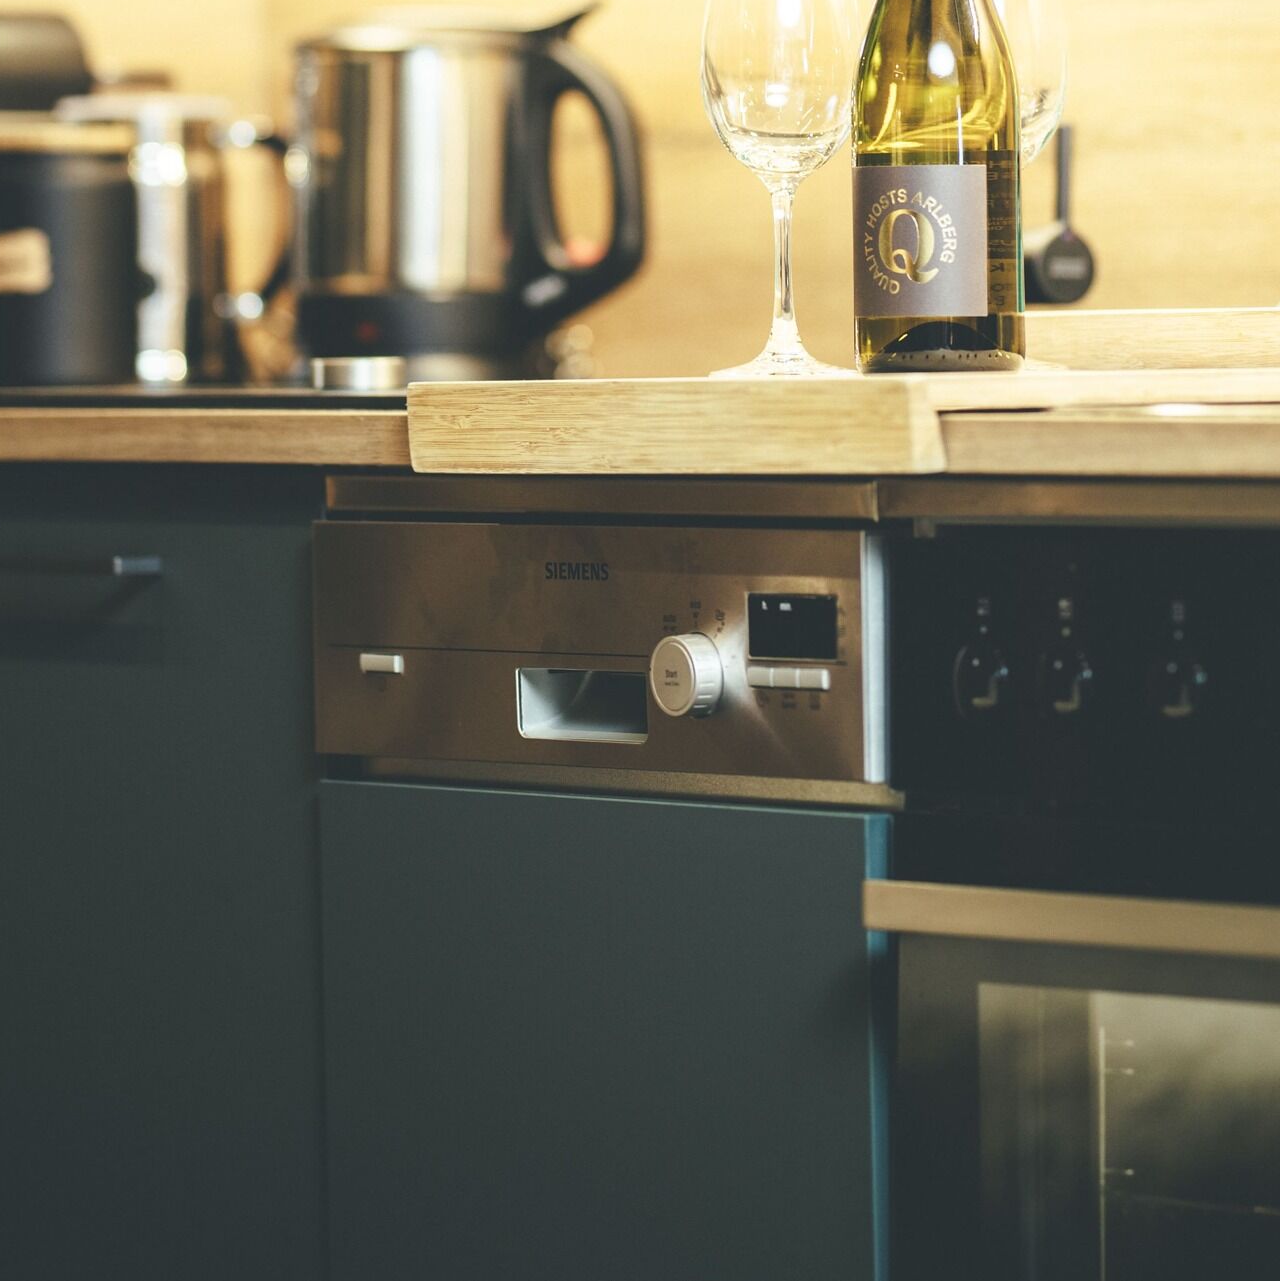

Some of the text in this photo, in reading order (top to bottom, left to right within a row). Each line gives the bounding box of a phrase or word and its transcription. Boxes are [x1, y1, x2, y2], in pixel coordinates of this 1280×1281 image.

[864, 188, 958, 295] QUALITY HOSTS ARLBERG
[878, 208, 939, 284] Q
[545, 562, 608, 581] SIEMENS
